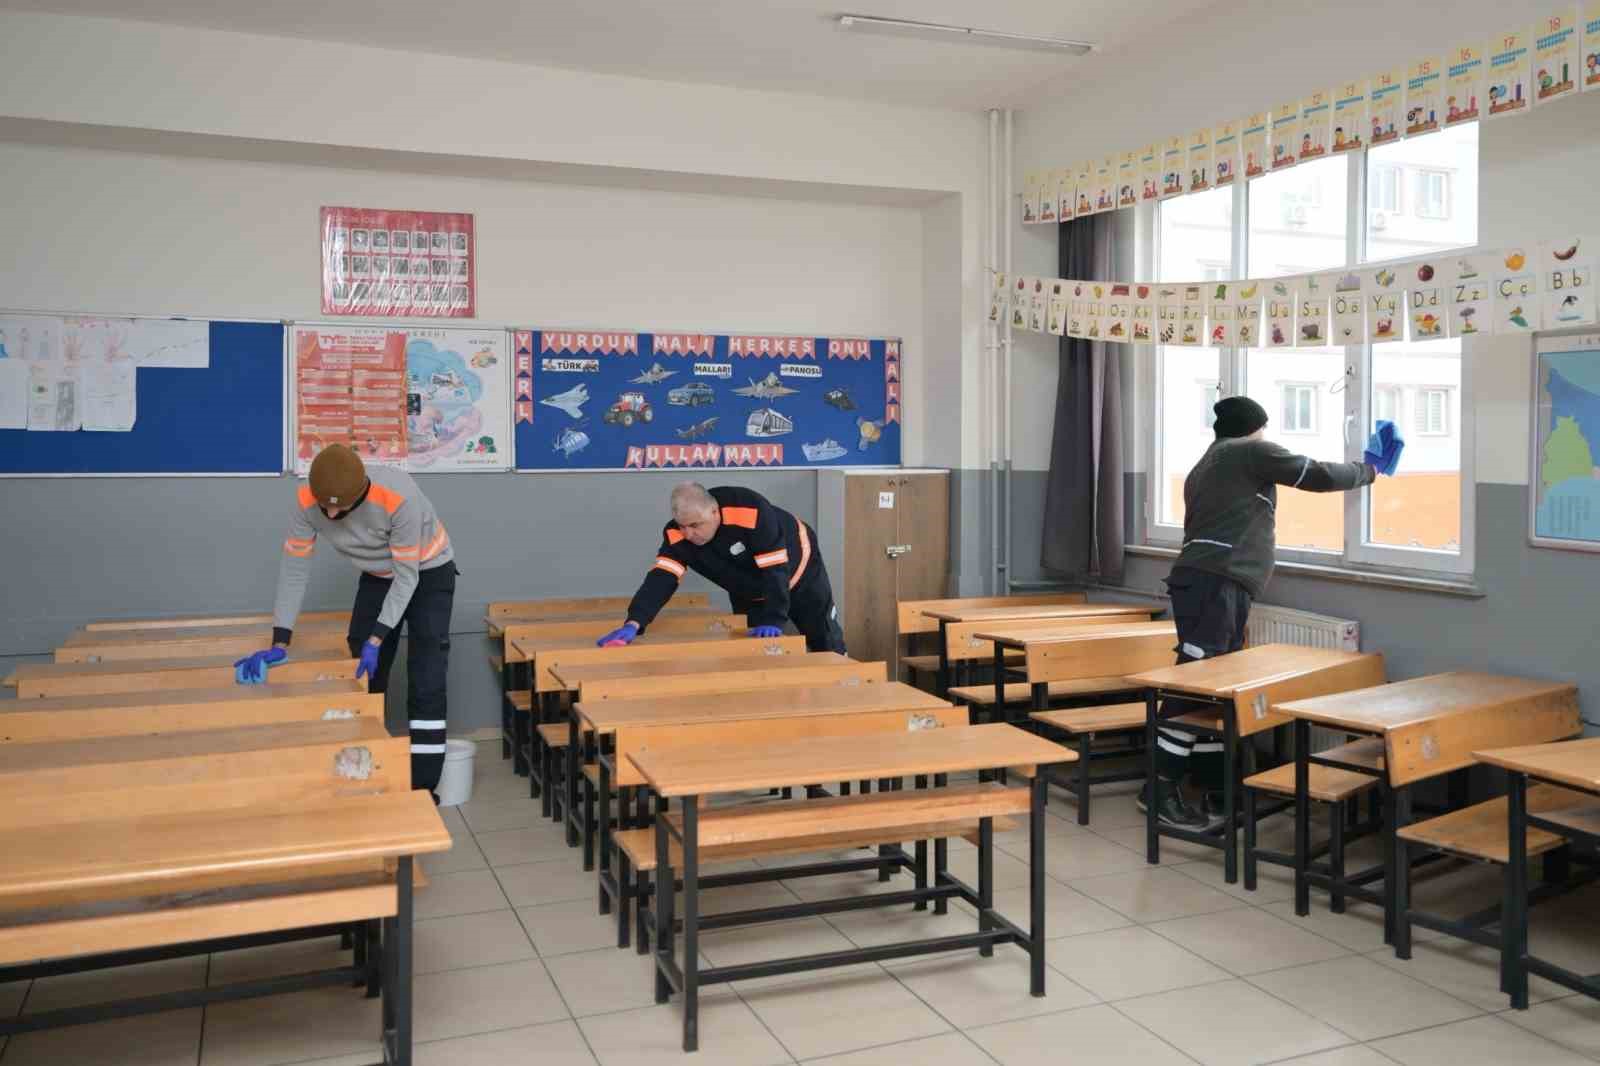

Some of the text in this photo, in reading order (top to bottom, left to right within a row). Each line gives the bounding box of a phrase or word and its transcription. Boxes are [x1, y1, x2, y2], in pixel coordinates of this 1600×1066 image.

[1549, 17, 1561, 30] 18
[1504, 36, 1516, 48] 17
[1460, 48, 1472, 61] 16
[1418, 62, 1430, 74] 15
[544, 333, 868, 353] YURDUN MALI HERKES ONU
[557, 360, 582, 370] TÜRK
[887, 342, 899, 418] MALI
